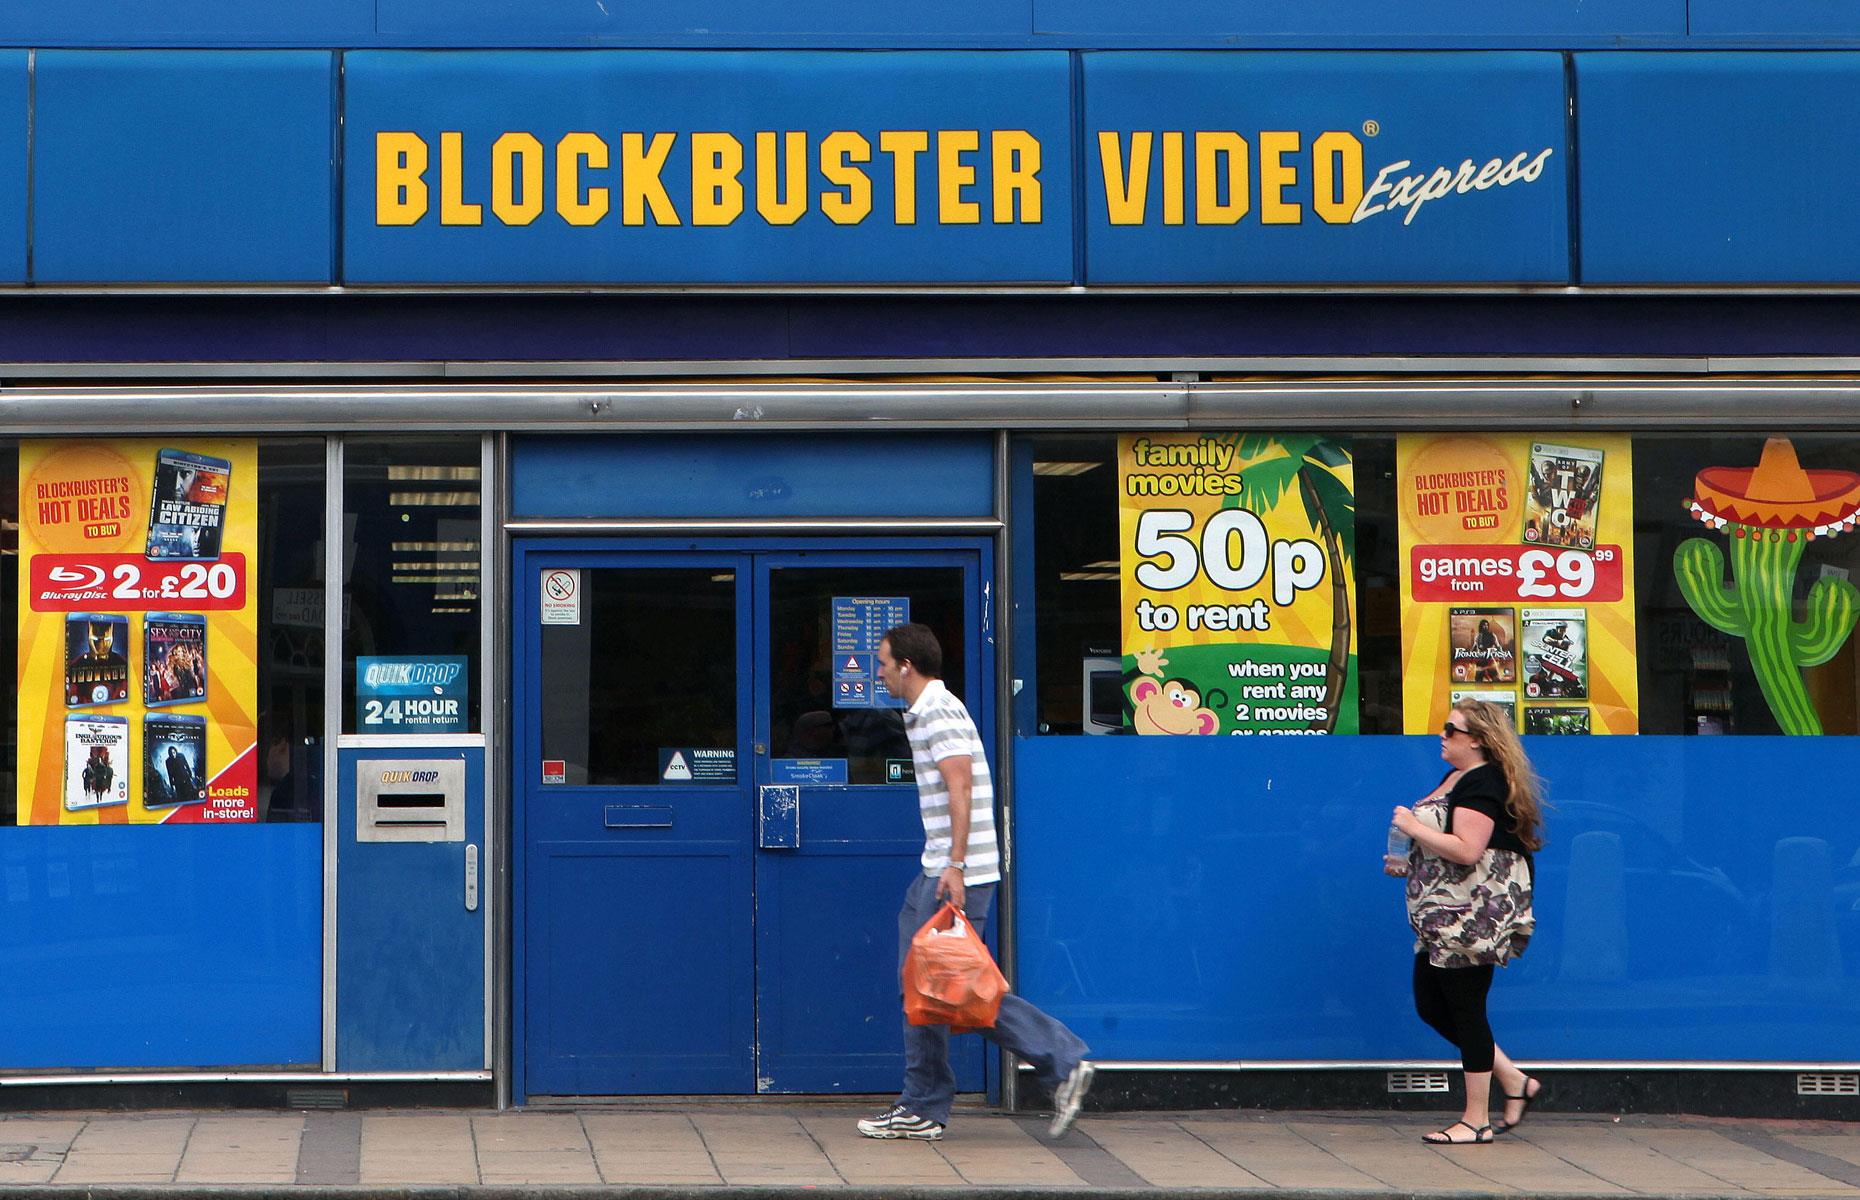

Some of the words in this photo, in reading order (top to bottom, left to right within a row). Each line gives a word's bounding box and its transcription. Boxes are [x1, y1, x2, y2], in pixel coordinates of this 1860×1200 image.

[375, 130, 1042, 227] BLOCKBUSTER
[1097, 130, 1364, 226] VIDEO
[1351, 148, 1553, 226] Express
[1133, 438, 1234, 471] family
[37, 477, 129, 500] BLOCKBUSTER'S
[1126, 468, 1243, 496] movies
[1415, 469, 1506, 491] BLOCKBUSTER'S
[39, 501, 73, 525] HOT
[77, 496, 131, 522] DEALS
[161, 503, 182, 512] LAW
[184, 504, 220, 515] ABIDING
[1416, 493, 1450, 516] HOT
[1455, 488, 1509, 513] DEALS
[159, 511, 219, 528] CITIZEN
[1465, 517, 1477, 528] TO
[1479, 516, 1496, 527] BUY
[87, 526, 99, 537] TO
[100, 524, 118, 536] BUY
[1134, 508, 1326, 606] 50p
[1419, 557, 1513, 582] games
[112, 564, 141, 599] 2
[142, 587, 160, 599] for
[160, 564, 236, 599] £20
[1450, 578, 1484, 591] from
[1136, 598, 1179, 630] to
[1186, 598, 1270, 631] rent
[179, 629, 202, 639] CITY
[1227, 660, 1285, 678] when
[1289, 663, 1327, 680] you
[1541, 652, 1574, 672] CELL
[1242, 682, 1287, 699] rent
[1290, 685, 1327, 702] any
[364, 700, 403, 724] 24
[405, 700, 458, 715] HOUR
[405, 716, 430, 724] rental
[432, 716, 459, 724] return
[1235, 705, 1250, 721] 2
[1254, 704, 1328, 721] movies
[693, 750, 735, 758] WARNING
[208, 785, 249, 797] Loads
[203, 807, 254, 819] in-store!
[212, 799, 245, 808] more
